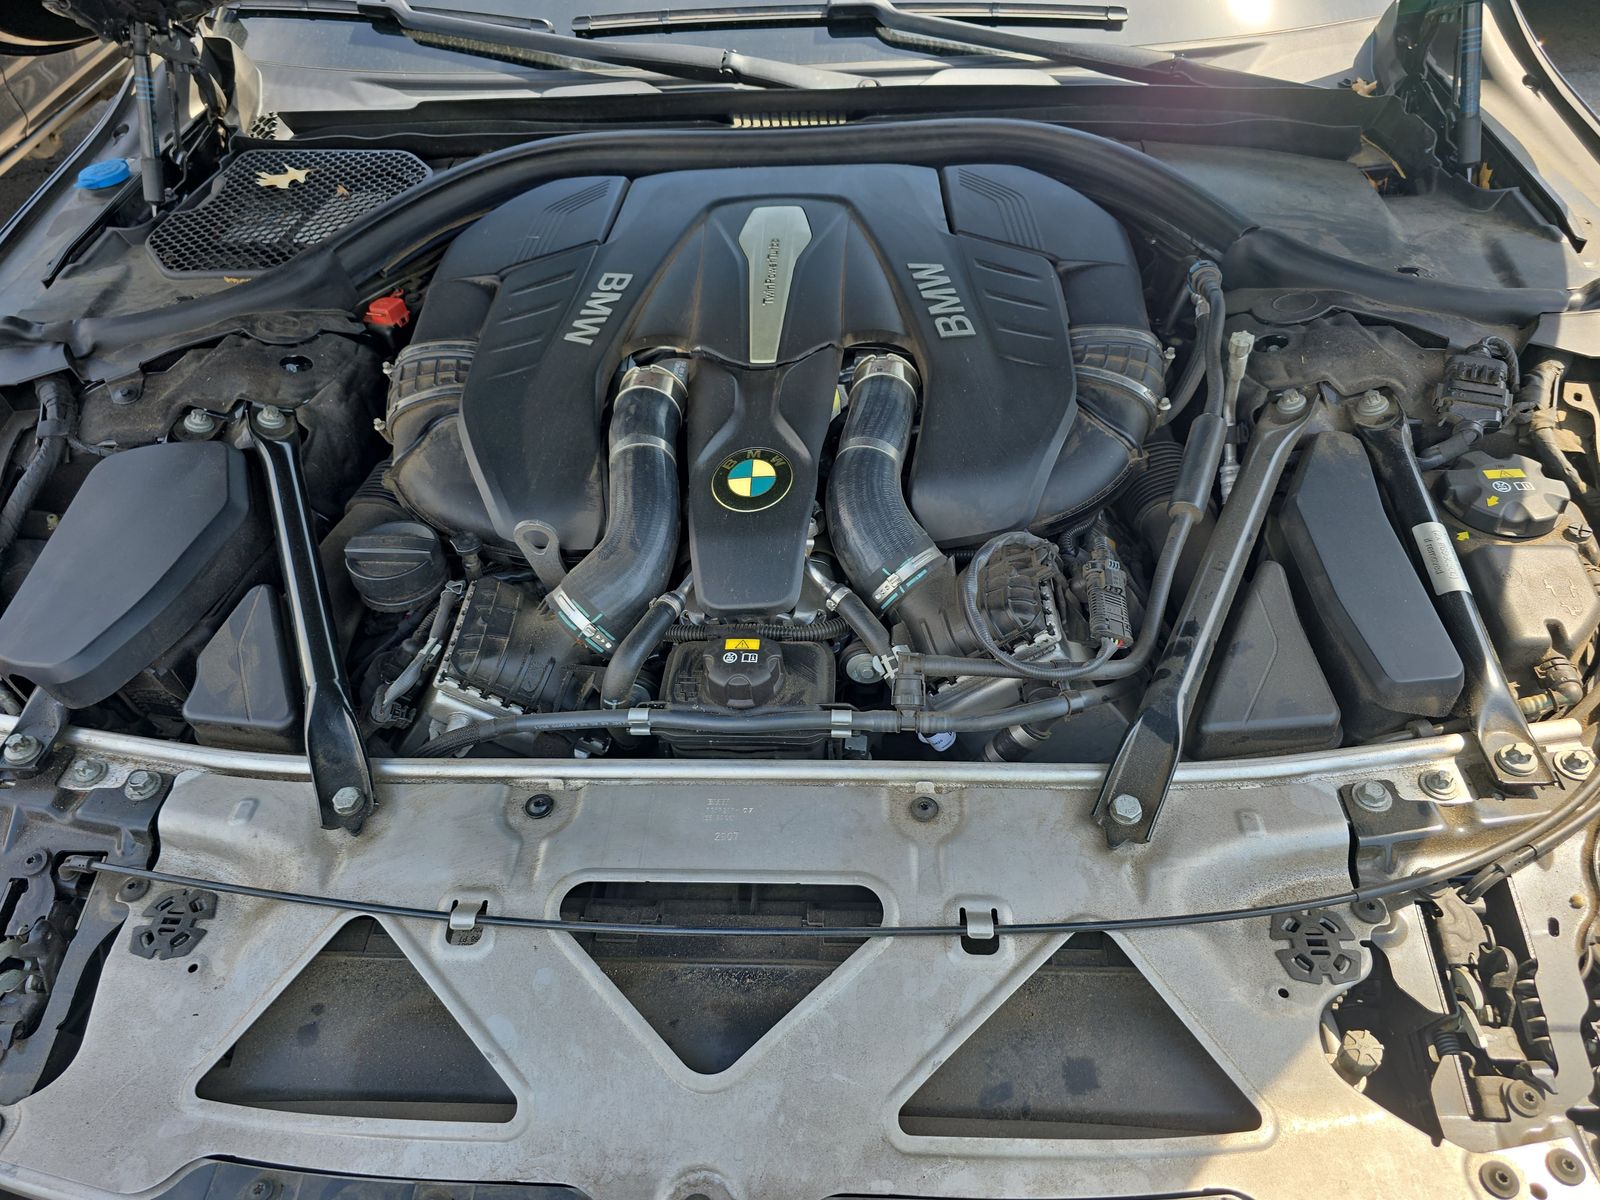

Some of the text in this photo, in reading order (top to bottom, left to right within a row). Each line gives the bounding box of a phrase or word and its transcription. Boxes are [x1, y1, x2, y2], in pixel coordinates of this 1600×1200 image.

[563, 272, 634, 346] BMW
[907, 263, 977, 338] BMW
[721, 449, 787, 471] BMW
